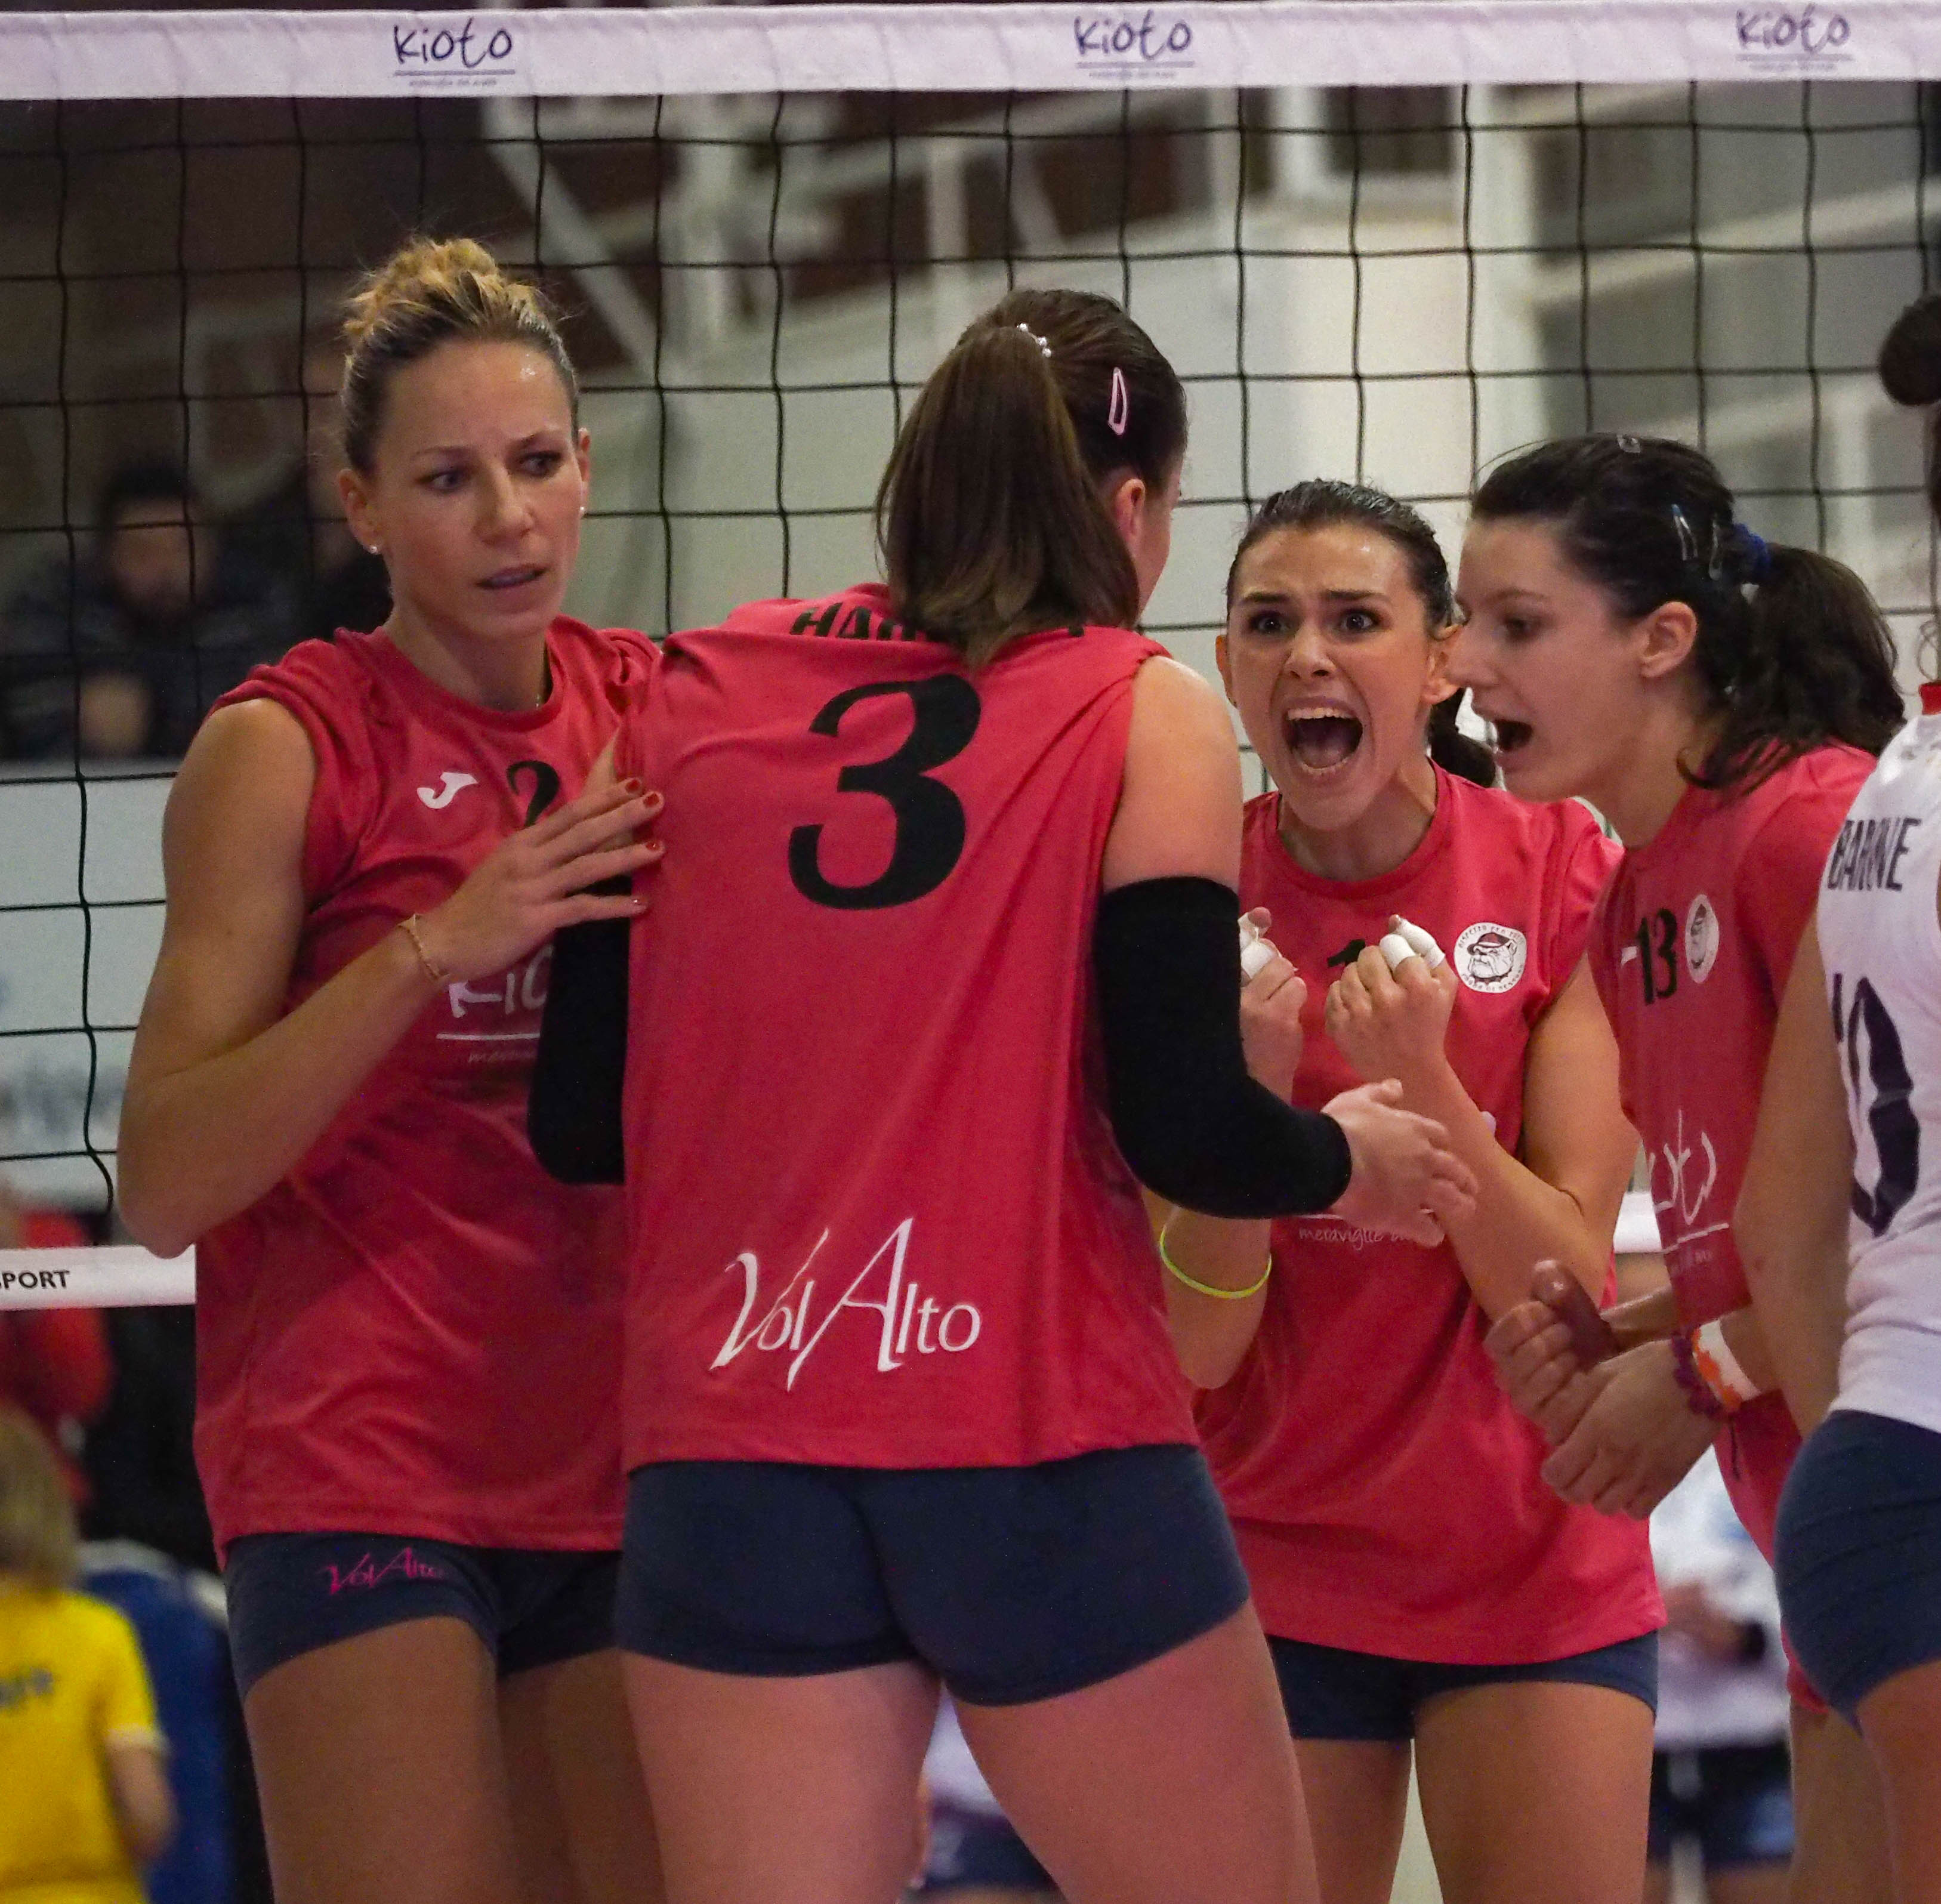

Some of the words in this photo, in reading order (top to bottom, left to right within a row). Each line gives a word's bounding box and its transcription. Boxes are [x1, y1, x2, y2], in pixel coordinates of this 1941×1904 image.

[788, 674, 982, 910] 3
[1637, 907, 1677, 1005] 13
[0, 1270, 70, 1289] PORT
[709, 1217, 981, 1392] VolAlto
